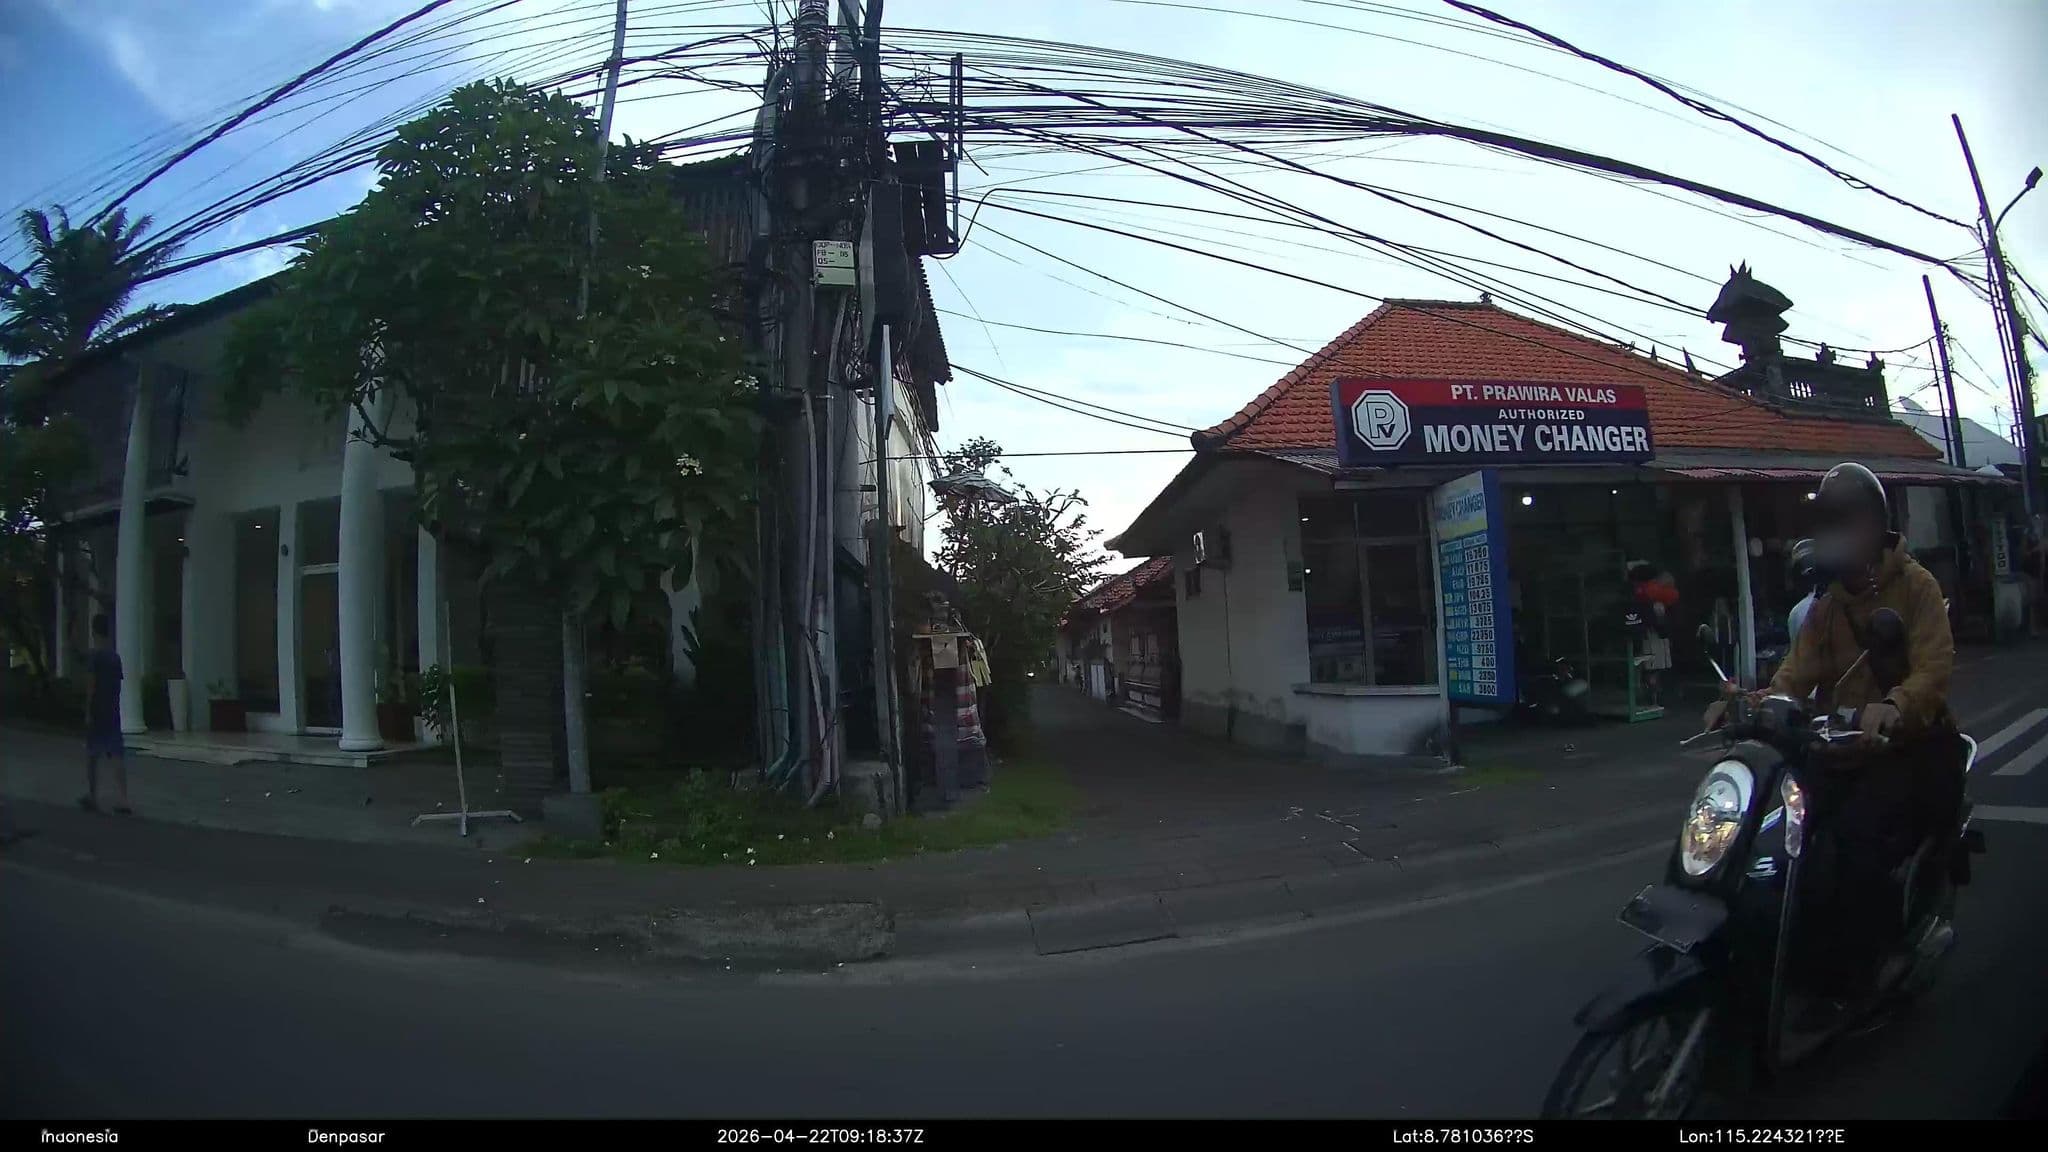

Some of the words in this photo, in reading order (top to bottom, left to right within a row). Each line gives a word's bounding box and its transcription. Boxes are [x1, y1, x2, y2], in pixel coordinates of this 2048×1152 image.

[1451, 384, 1478, 400] PT.
[1483, 385, 1562, 403] PRAWIRA
[1564, 387, 1617, 403] VALAS
[1498, 408, 1585, 420] AUTHORIZED
[1423, 424, 1531, 453] MONEY
[1534, 424, 1650, 452] CHANGER
